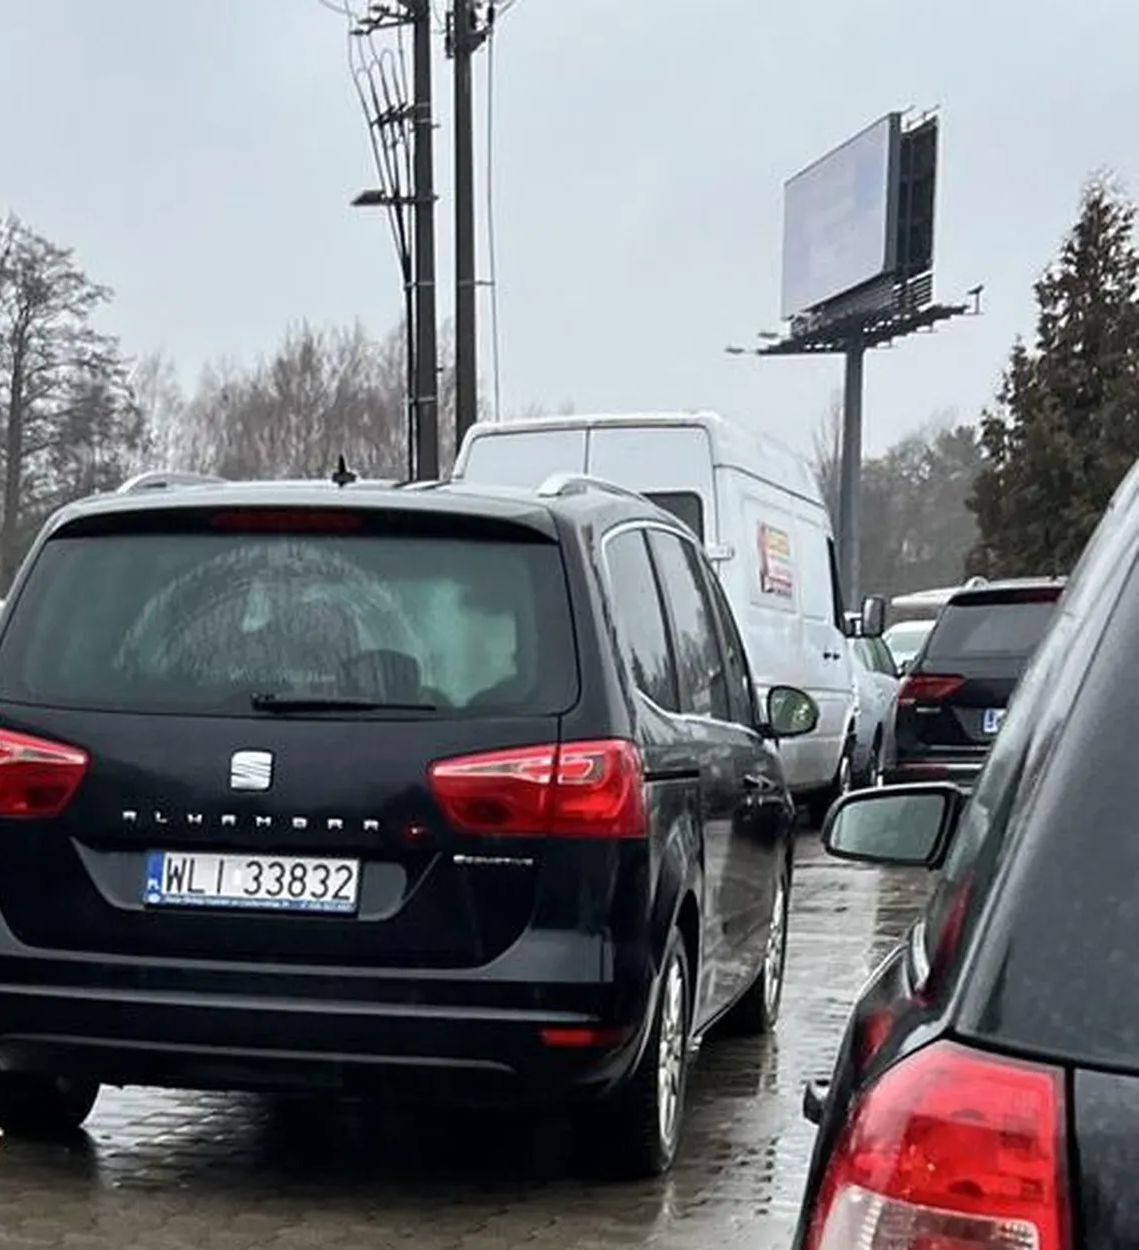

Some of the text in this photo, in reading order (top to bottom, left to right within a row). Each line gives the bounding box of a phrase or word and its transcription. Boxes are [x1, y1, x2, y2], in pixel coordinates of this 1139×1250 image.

[122, 811, 380, 831] ALHAMBRA
[166, 857, 354, 901] WLI 33832
